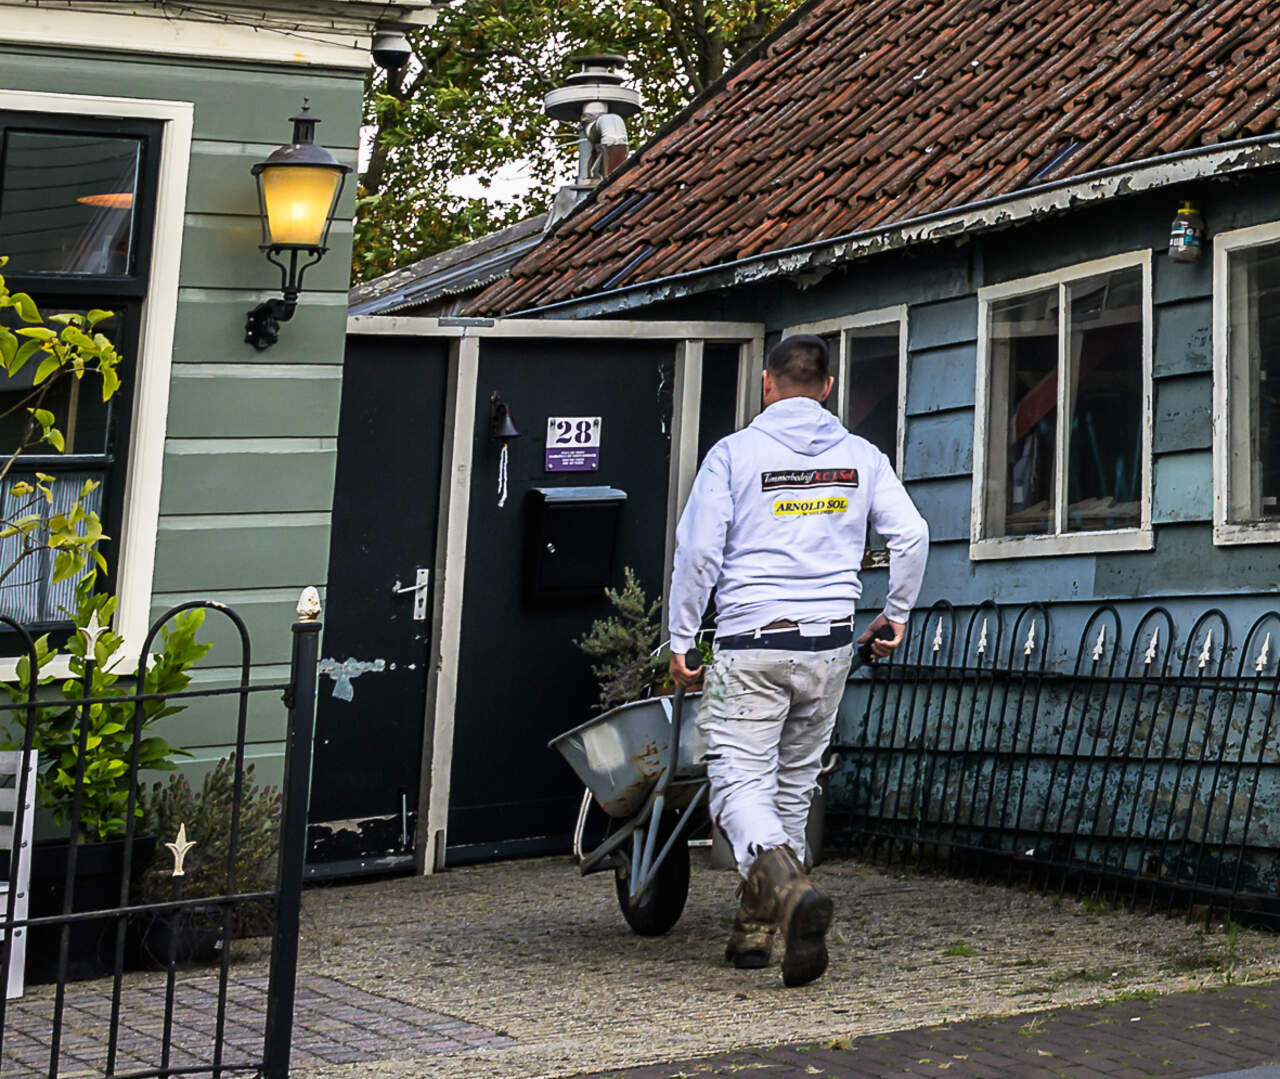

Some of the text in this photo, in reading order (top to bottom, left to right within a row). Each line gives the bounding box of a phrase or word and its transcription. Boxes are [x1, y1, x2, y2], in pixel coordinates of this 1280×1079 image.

[556, 420, 592, 444] 28
[776, 499, 845, 512] ARNOLD SOL
